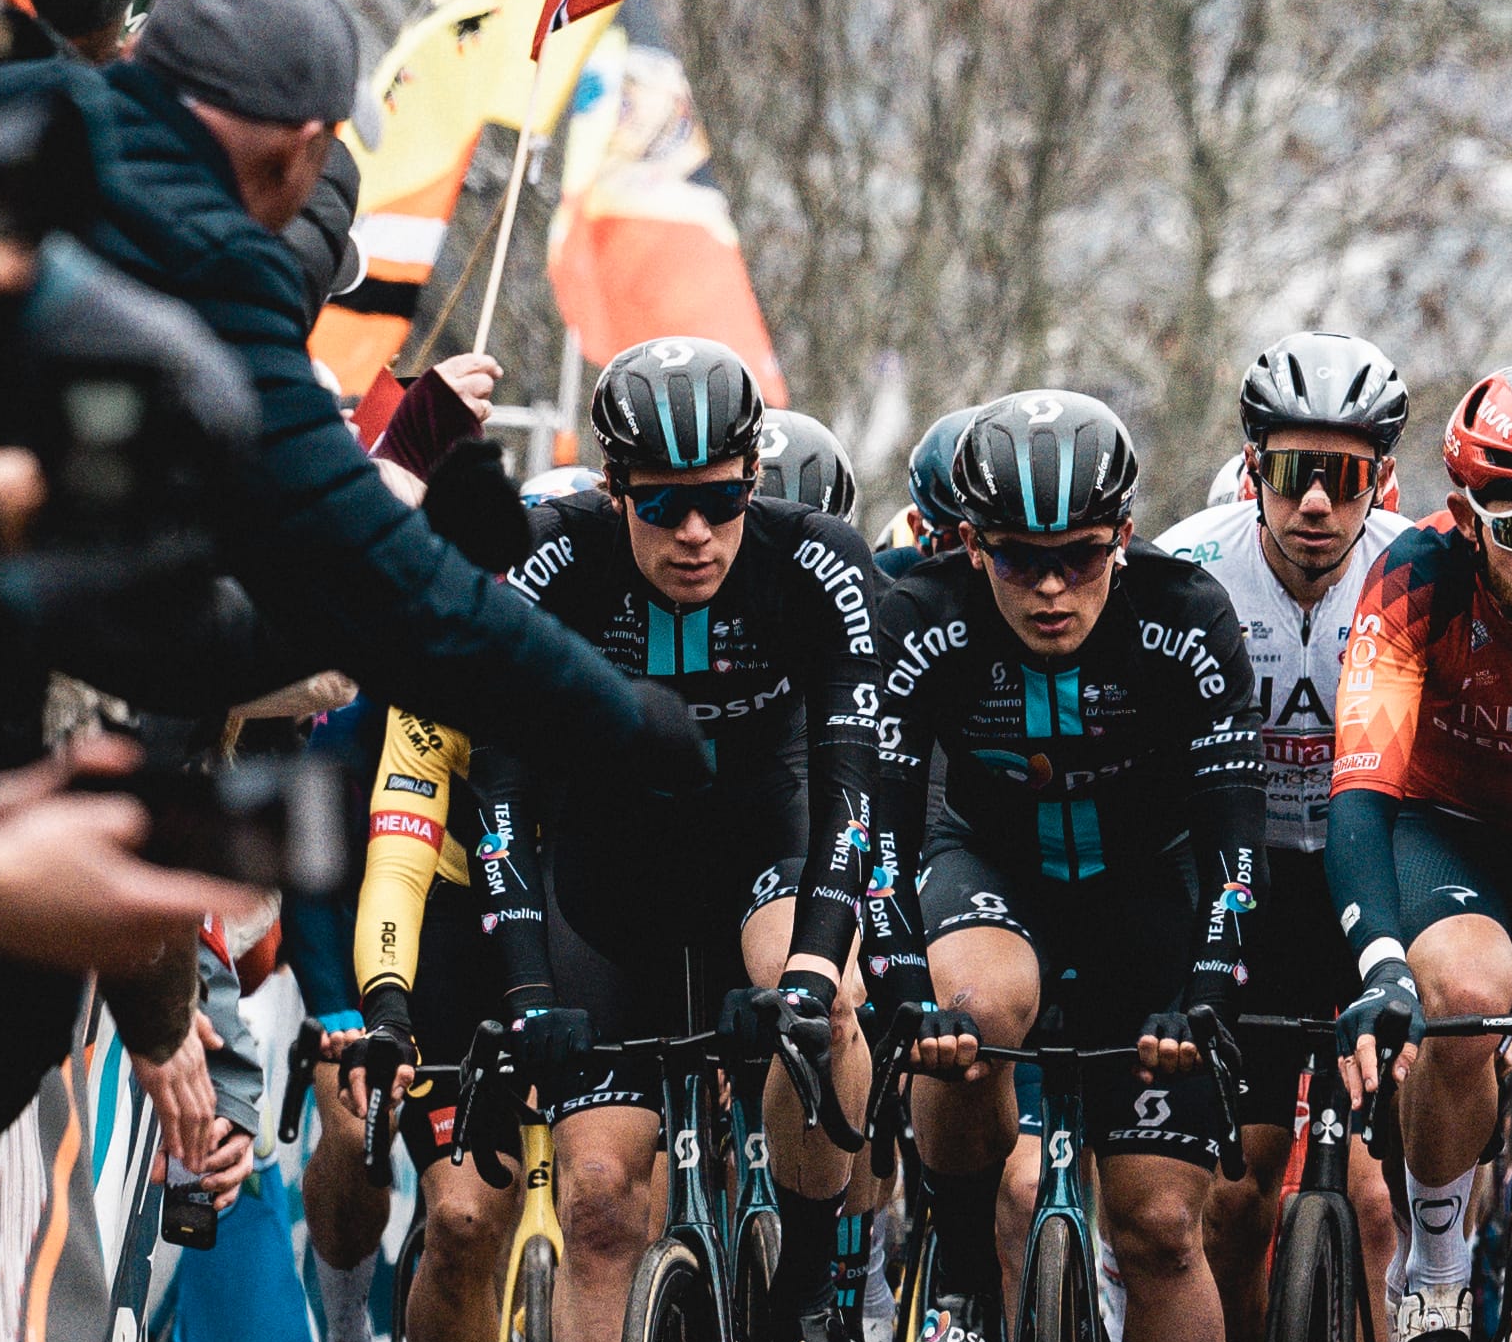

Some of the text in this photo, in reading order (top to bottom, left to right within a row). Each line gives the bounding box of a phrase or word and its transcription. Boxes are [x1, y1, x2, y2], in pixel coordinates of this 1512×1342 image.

[505, 534, 576, 605] fone
[1342, 613, 1381, 729] INEOS
[687, 676, 791, 722] DSM
[825, 714, 880, 732] SCO
[1189, 730, 1258, 752] SCOTT
[878, 750, 922, 767] OTT
[374, 814, 433, 841] HEMA
[829, 791, 871, 872] TEAM DSM
[484, 802, 514, 896] TEAM DSM
[811, 885, 856, 907] Nalini
[868, 831, 901, 938] TEAM DSM
[1207, 847, 1253, 944] TEAM DSM
[499, 908, 543, 922] Nalini
[1192, 959, 1235, 975] Nalini
[561, 1090, 645, 1112] SCOTT
[1107, 1127, 1200, 1146] SCOTT
